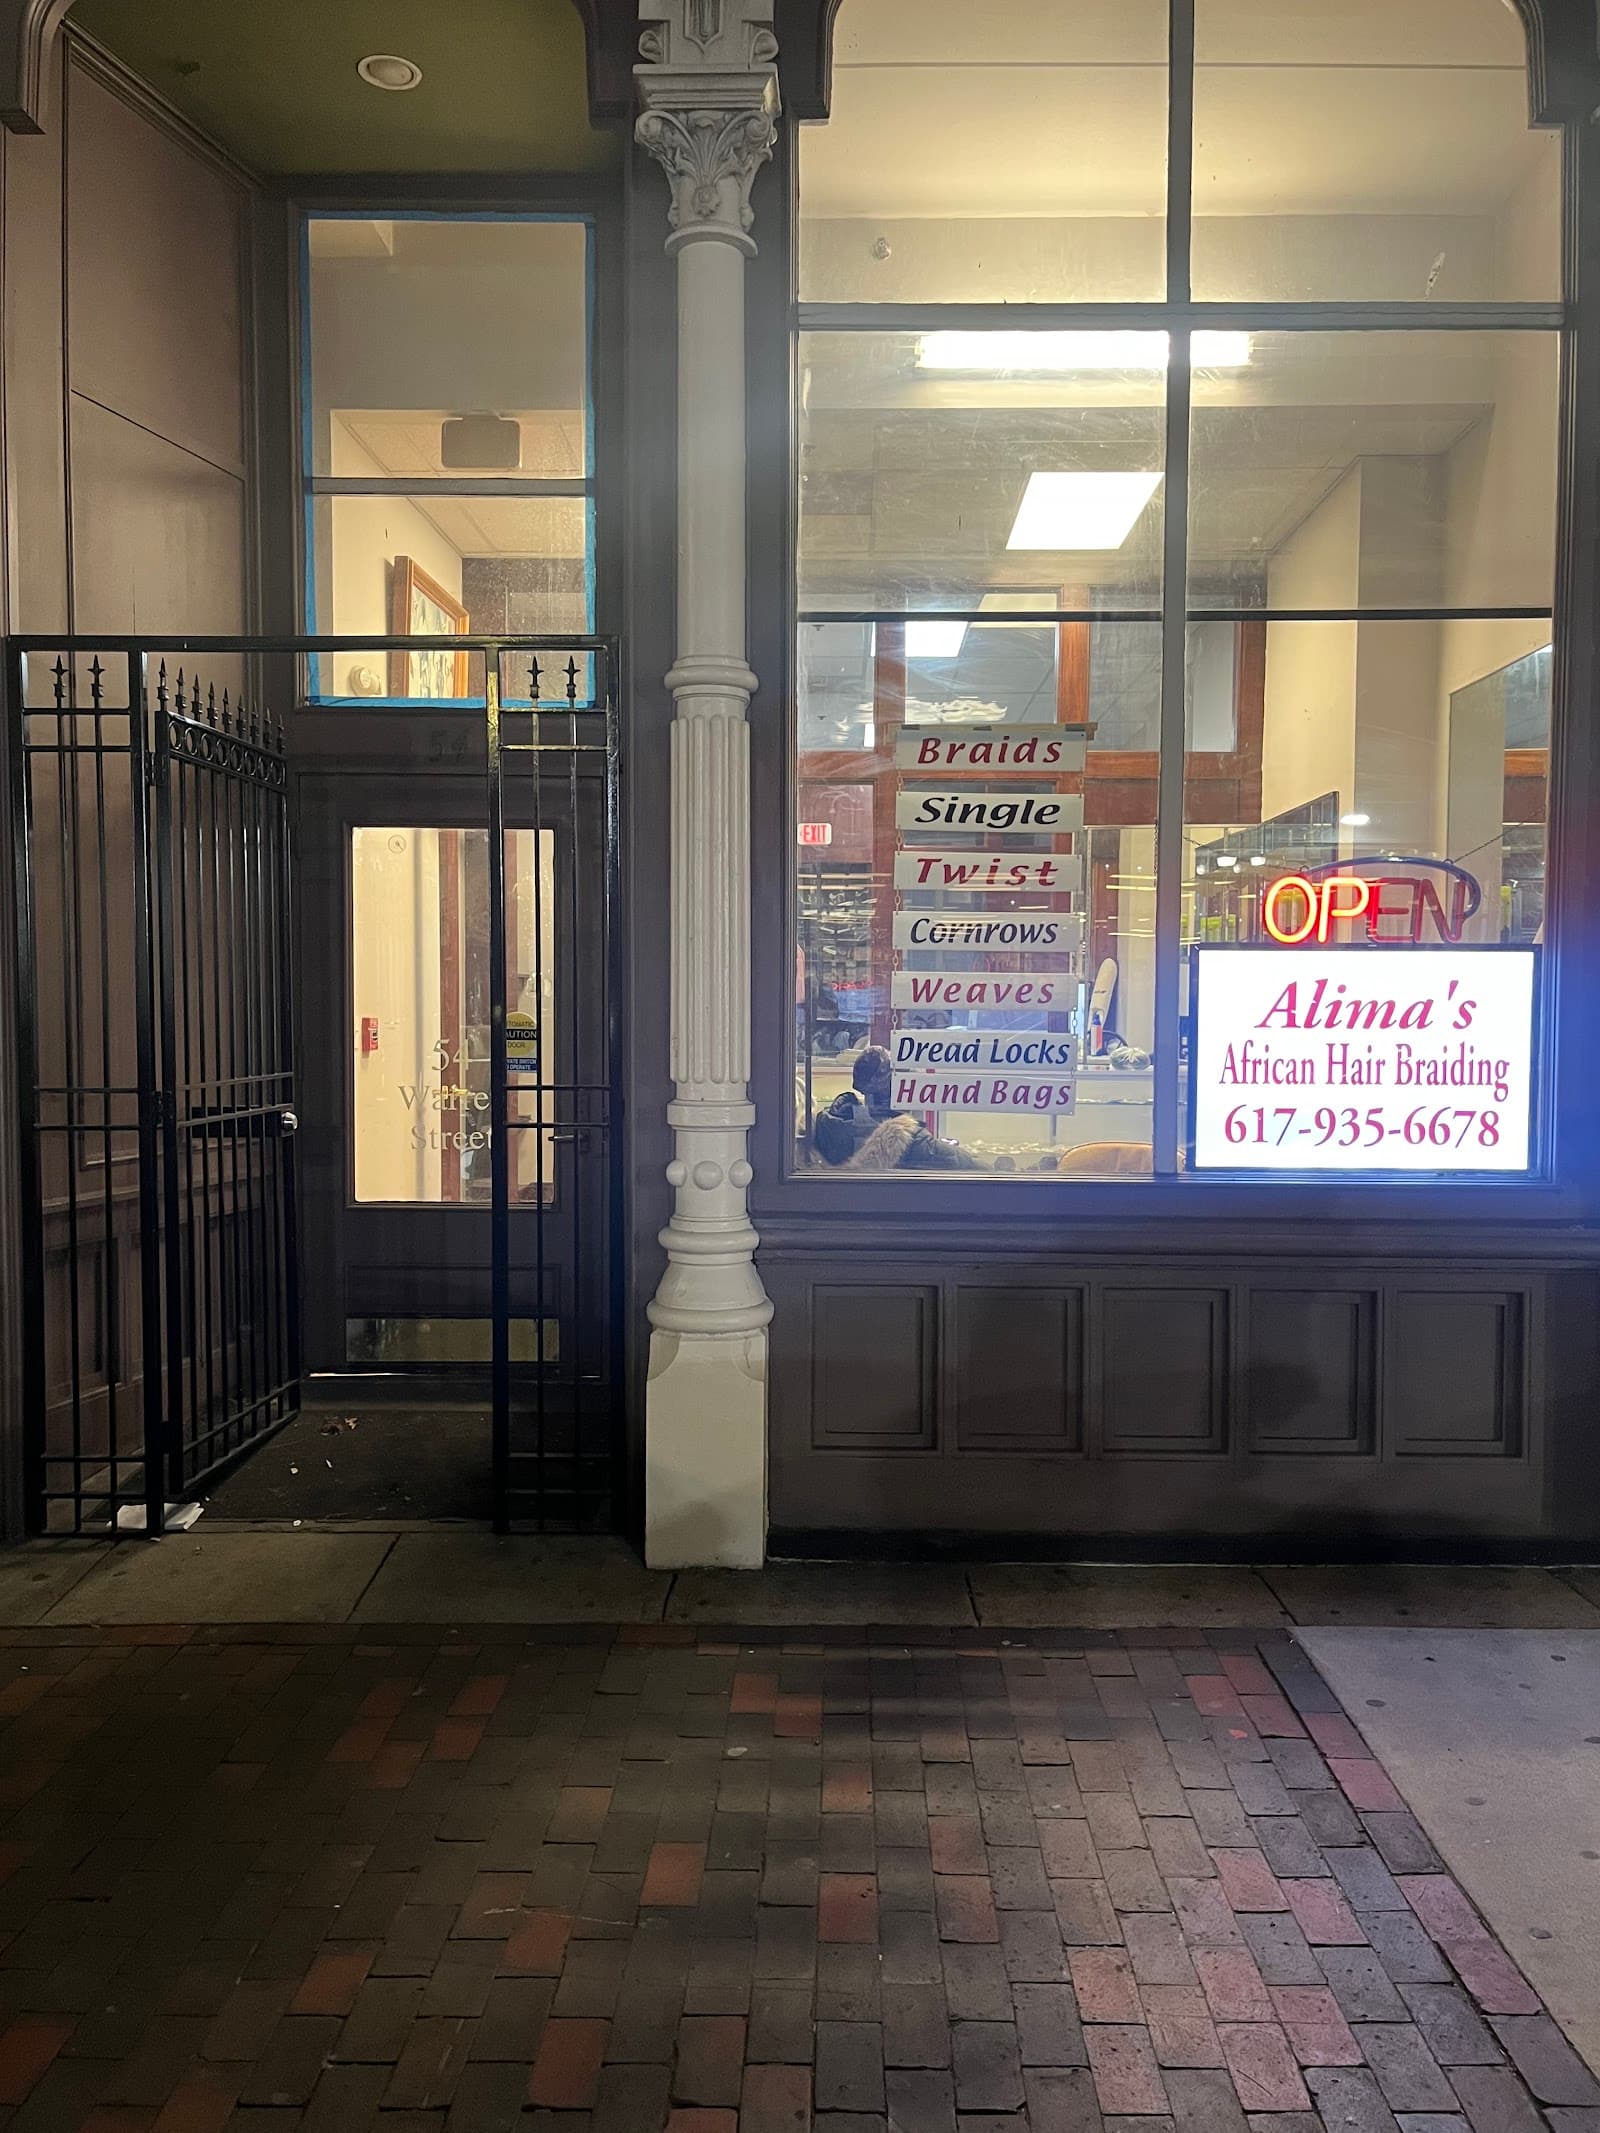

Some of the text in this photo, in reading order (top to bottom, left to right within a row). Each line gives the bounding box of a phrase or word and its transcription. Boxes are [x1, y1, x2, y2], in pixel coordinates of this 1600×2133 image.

[917, 737, 1063, 767] Braids
[914, 796, 1061, 829] Single
[803, 824, 827, 843] EXIT
[916, 858, 1059, 887] Twist
[1264, 875, 1466, 944] OPEN
[910, 917, 1058, 944] Cornrows
[911, 977, 1054, 1004] Weaves
[1254, 978, 1478, 1030] Alima's
[431, 1038, 472, 1072] 54
[897, 1036, 1070, 1065] Dread Locks
[1219, 1040, 1510, 1102] African Hair Braiding
[398, 1085, 491, 1111] Warre
[897, 1078, 1071, 1109] Hand Bags
[1224, 1104, 1500, 1148] 617-935-6678
